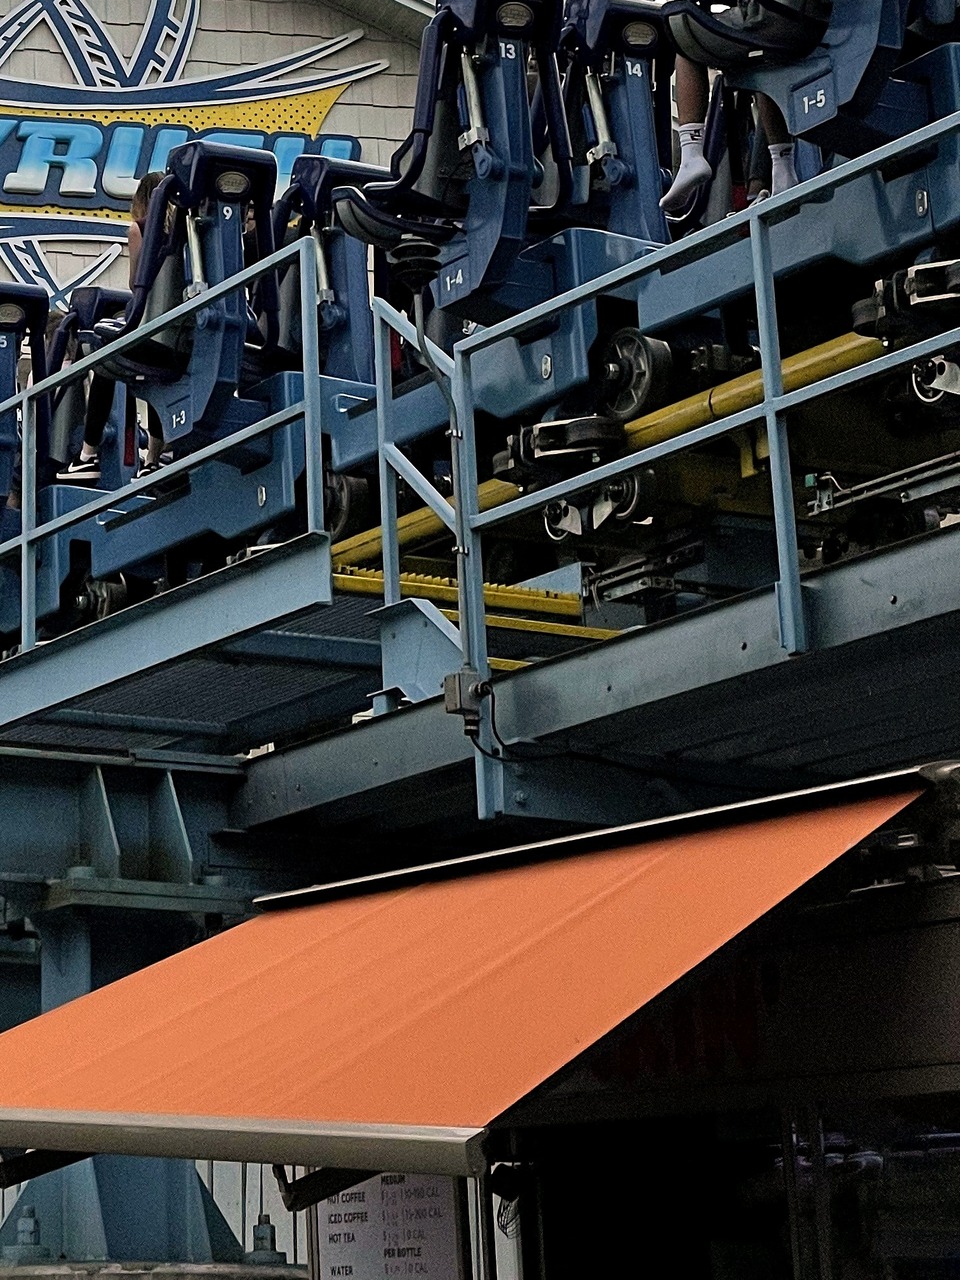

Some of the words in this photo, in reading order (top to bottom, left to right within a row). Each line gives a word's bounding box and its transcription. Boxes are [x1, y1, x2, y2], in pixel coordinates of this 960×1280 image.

[499, 42, 516, 59] 13
[625, 61, 643, 78] 14
[803, 89, 826, 114] 1-5
[222, 206, 233, 220] 9
[445, 269, 463, 292] 1-4
[0, 335, 8, 348] 5
[172, 410, 187, 429] 1-3
[341, 1191, 365, 1203] COFFEE
[328, 1213, 342, 1224] ICED
[344, 1212, 368, 1223] COFFEE
[329, 1233, 341, 1244] HOT
[344, 1232, 356, 1243] TEA
[397, 1247, 422, 1258] BOTTLE
[330, 1265, 353, 1275] WATER
